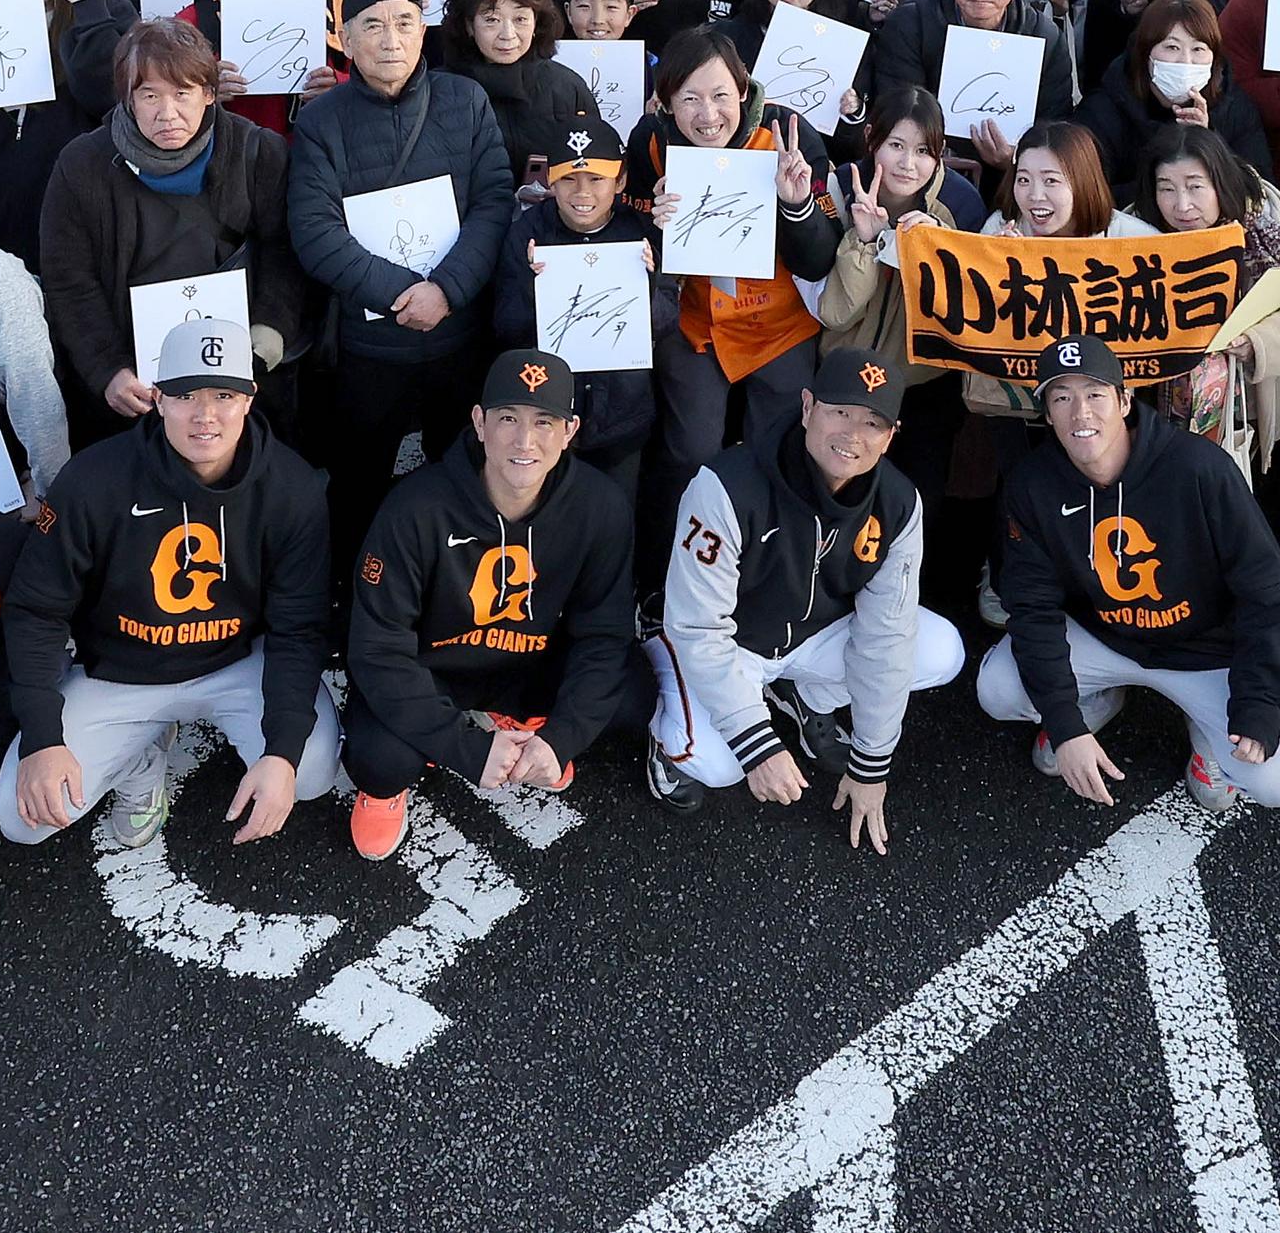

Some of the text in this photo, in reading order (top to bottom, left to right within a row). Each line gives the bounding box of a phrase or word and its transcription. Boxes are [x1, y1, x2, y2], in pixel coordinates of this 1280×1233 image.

[919, 245, 1245, 344] 小林誠司
[680, 515, 723, 567] 73
[853, 514, 882, 565] G
[1093, 515, 1163, 603] G
[149, 522, 222, 615] G
[467, 544, 538, 626] G
[118, 615, 241, 647] TOKYO GIANTS
[1136, 601, 1191, 629] GIANTS
[485, 630, 548, 653] GIANTS
